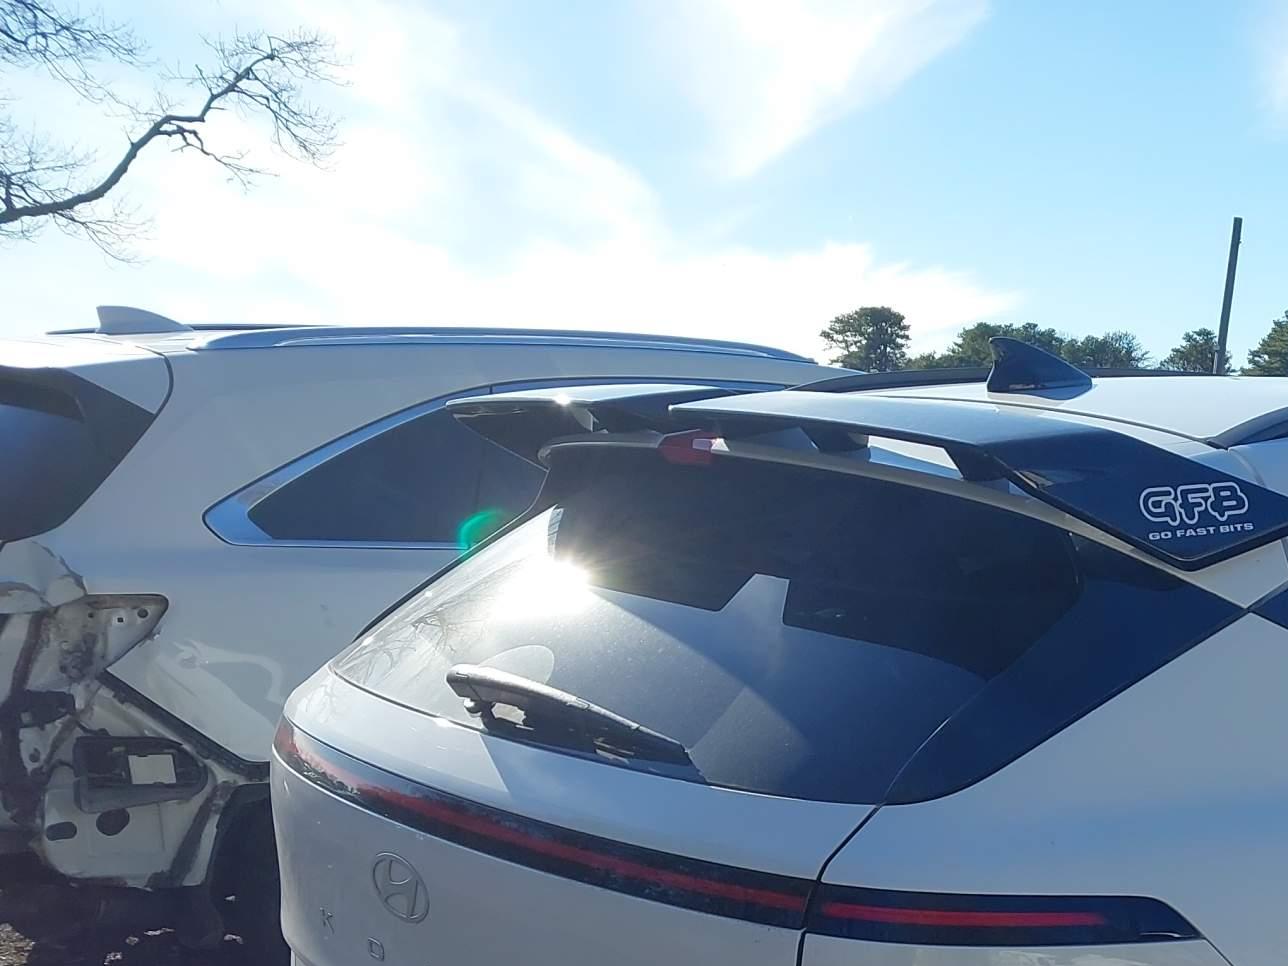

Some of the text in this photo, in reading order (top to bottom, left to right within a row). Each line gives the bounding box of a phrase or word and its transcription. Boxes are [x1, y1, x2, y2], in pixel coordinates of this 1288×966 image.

[1139, 481, 1249, 526] GFB
[1148, 522, 1254, 541] GO FAST BITS
